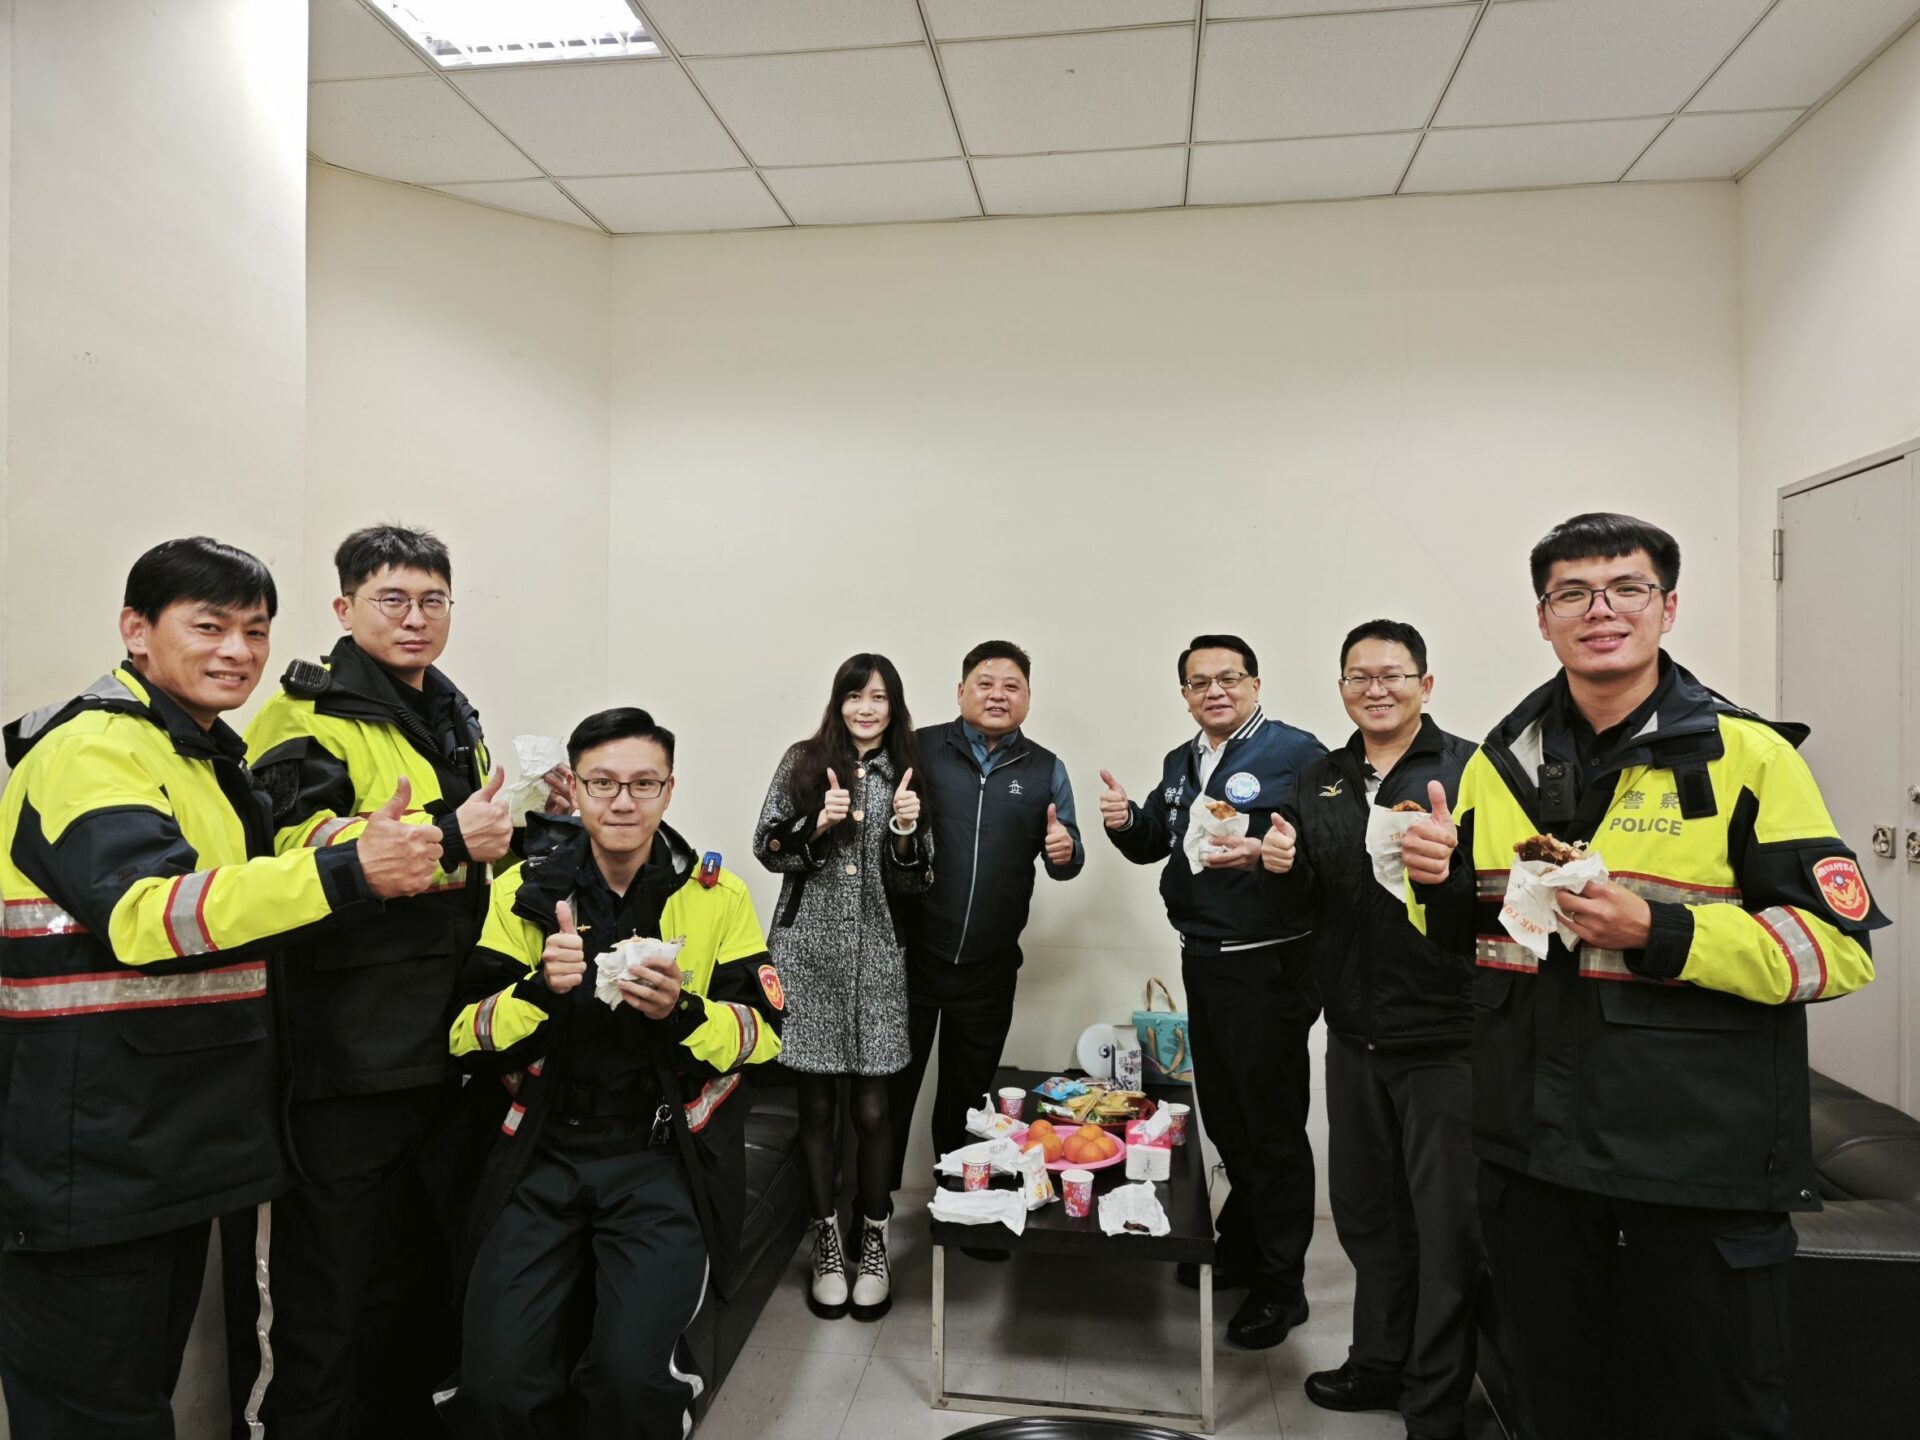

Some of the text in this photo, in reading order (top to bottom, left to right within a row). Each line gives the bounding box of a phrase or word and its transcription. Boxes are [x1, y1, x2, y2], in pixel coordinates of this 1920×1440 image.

[1609, 817, 1683, 836] POLICE
[1503, 903, 1544, 935] ANK YO
